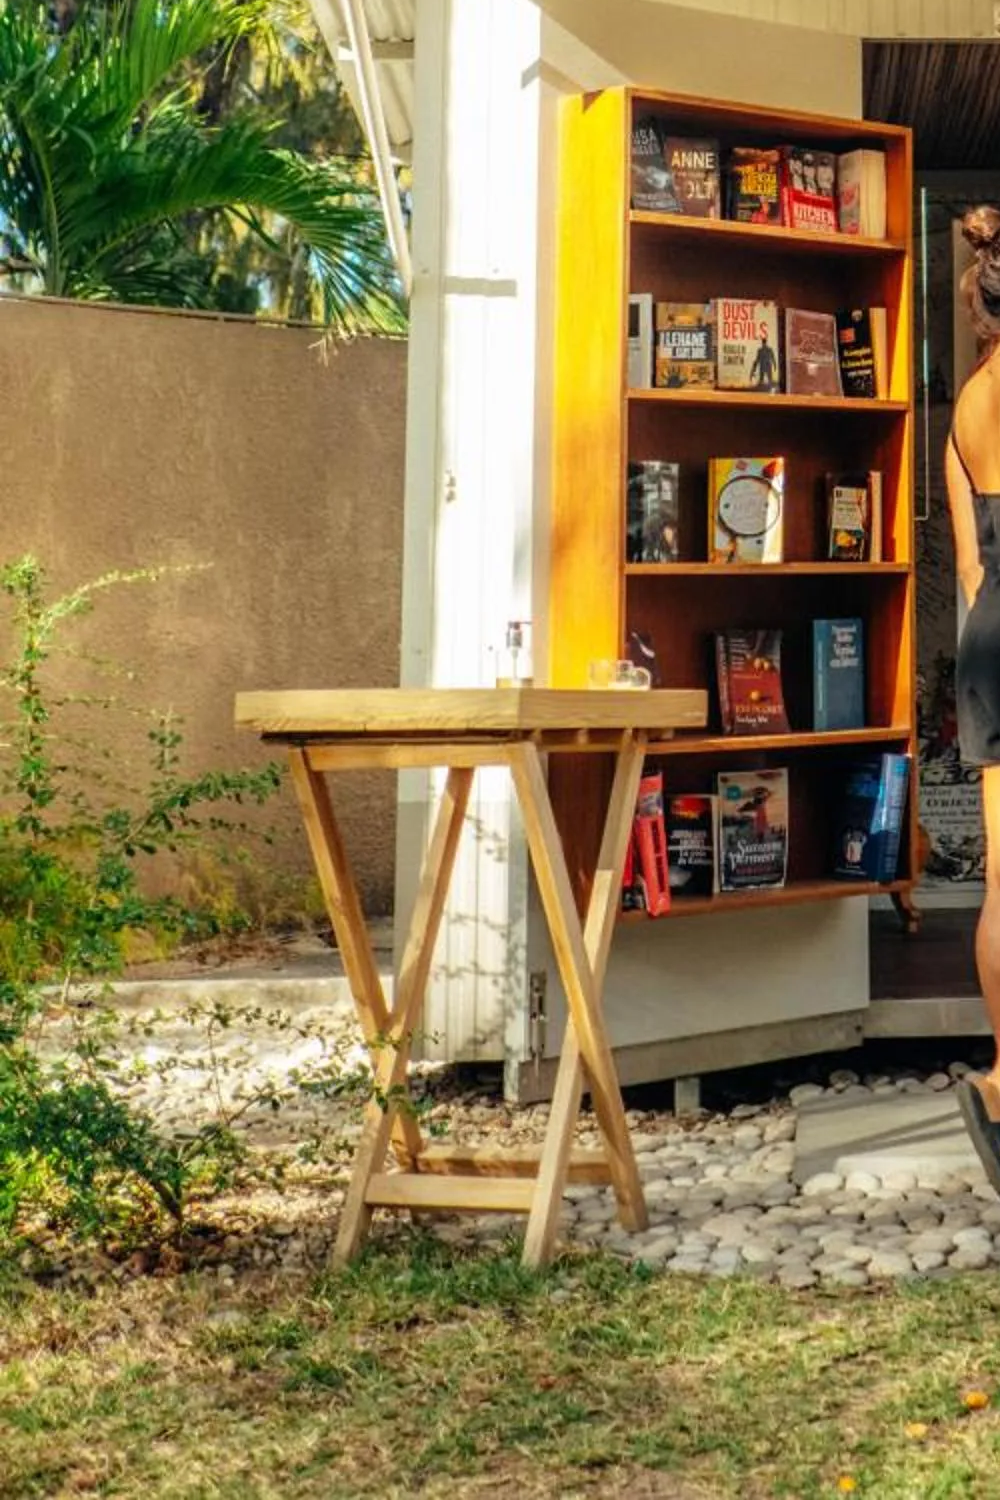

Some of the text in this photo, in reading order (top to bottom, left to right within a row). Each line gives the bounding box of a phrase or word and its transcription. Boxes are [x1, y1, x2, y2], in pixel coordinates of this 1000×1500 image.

[671, 150, 716, 169] ANNE
[723, 301, 756, 321] DUST
[723, 320, 769, 340] DEVILS
